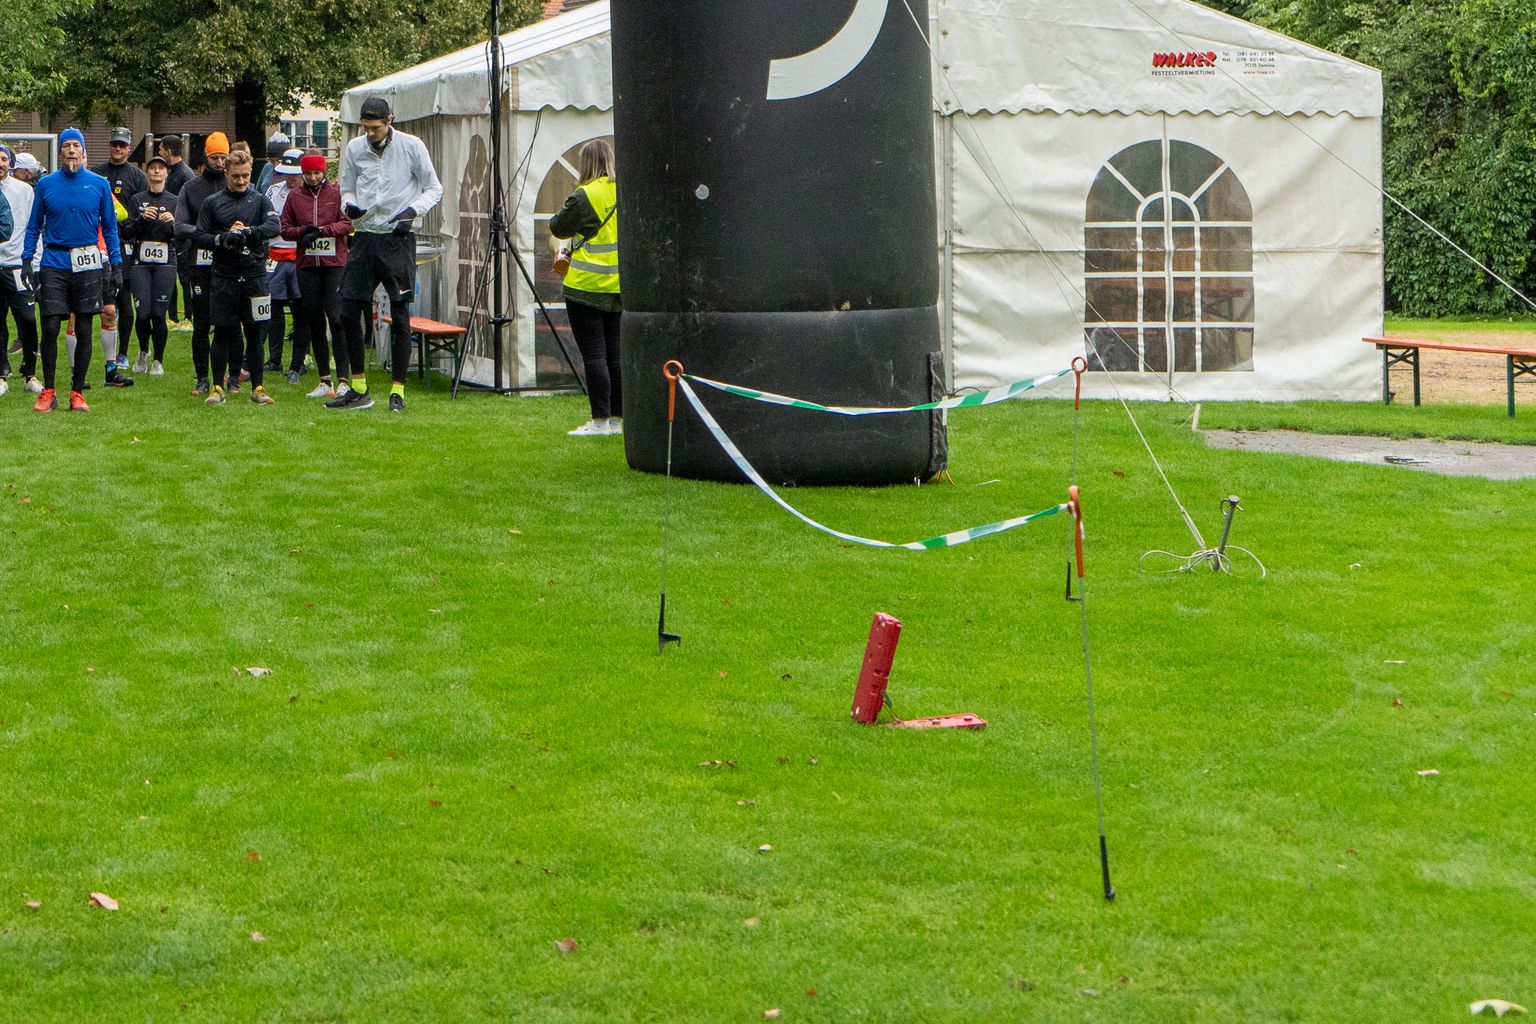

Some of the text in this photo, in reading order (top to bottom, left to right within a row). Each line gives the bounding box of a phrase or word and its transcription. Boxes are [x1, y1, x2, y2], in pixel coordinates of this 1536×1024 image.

[1152, 51, 1217, 68] WALKER
[310, 240, 331, 251] 042
[77, 253, 97, 266] 051
[145, 248, 163, 259] 043
